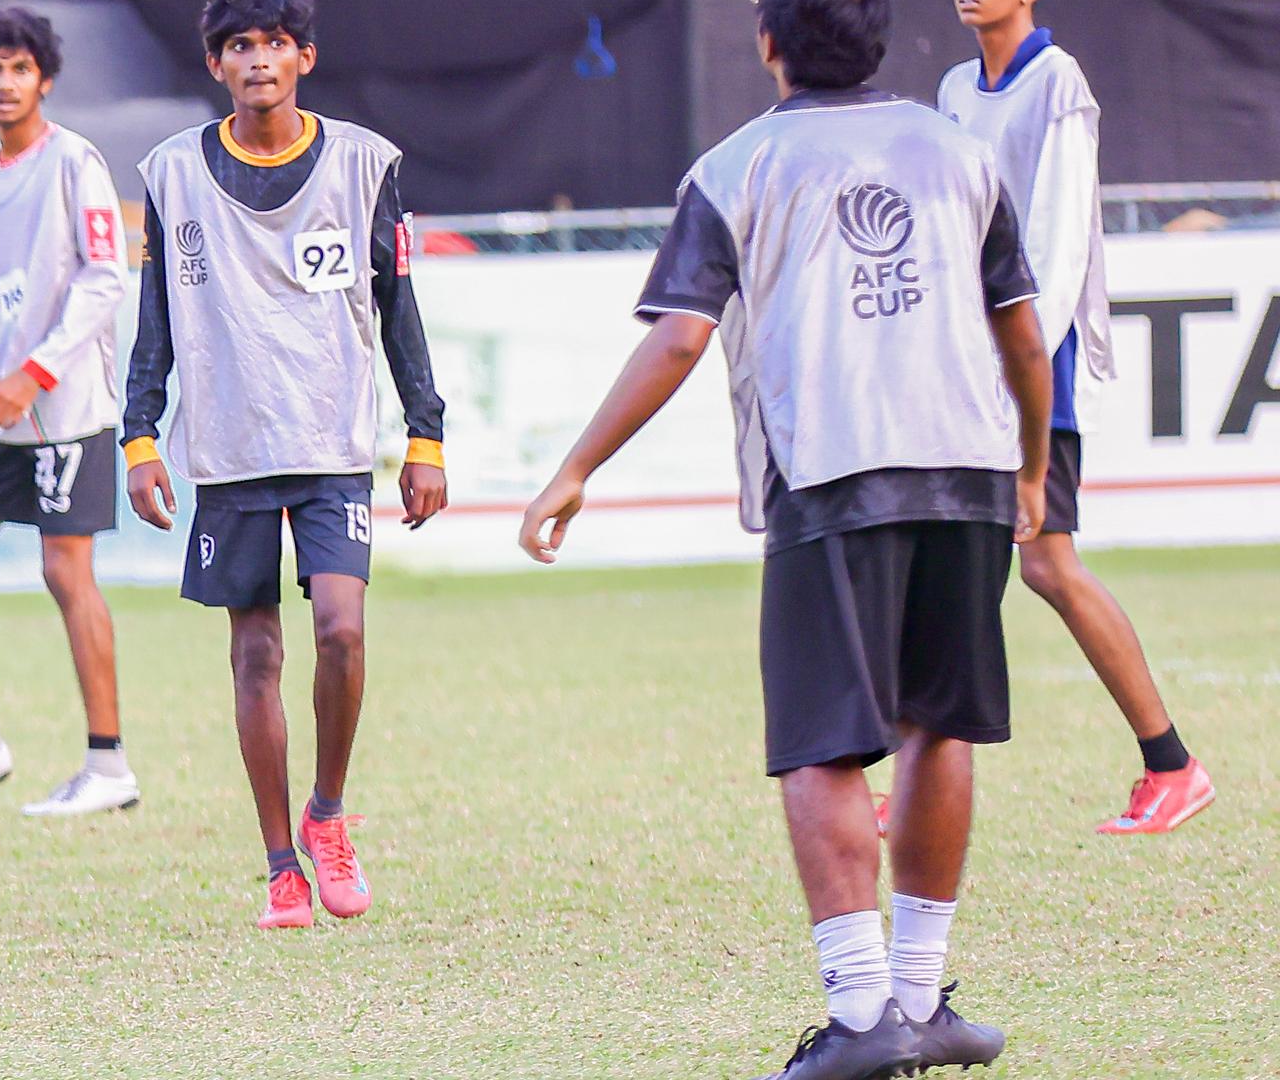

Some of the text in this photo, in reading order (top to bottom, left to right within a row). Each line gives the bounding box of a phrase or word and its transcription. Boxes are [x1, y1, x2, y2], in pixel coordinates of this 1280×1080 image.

[179, 258, 206, 272] AFC
[303, 243, 349, 278] 92
[850, 257, 920, 289] AFC
[180, 273, 208, 286] CUP
[852, 287, 924, 319] CUP
[343, 502, 371, 545] 19
